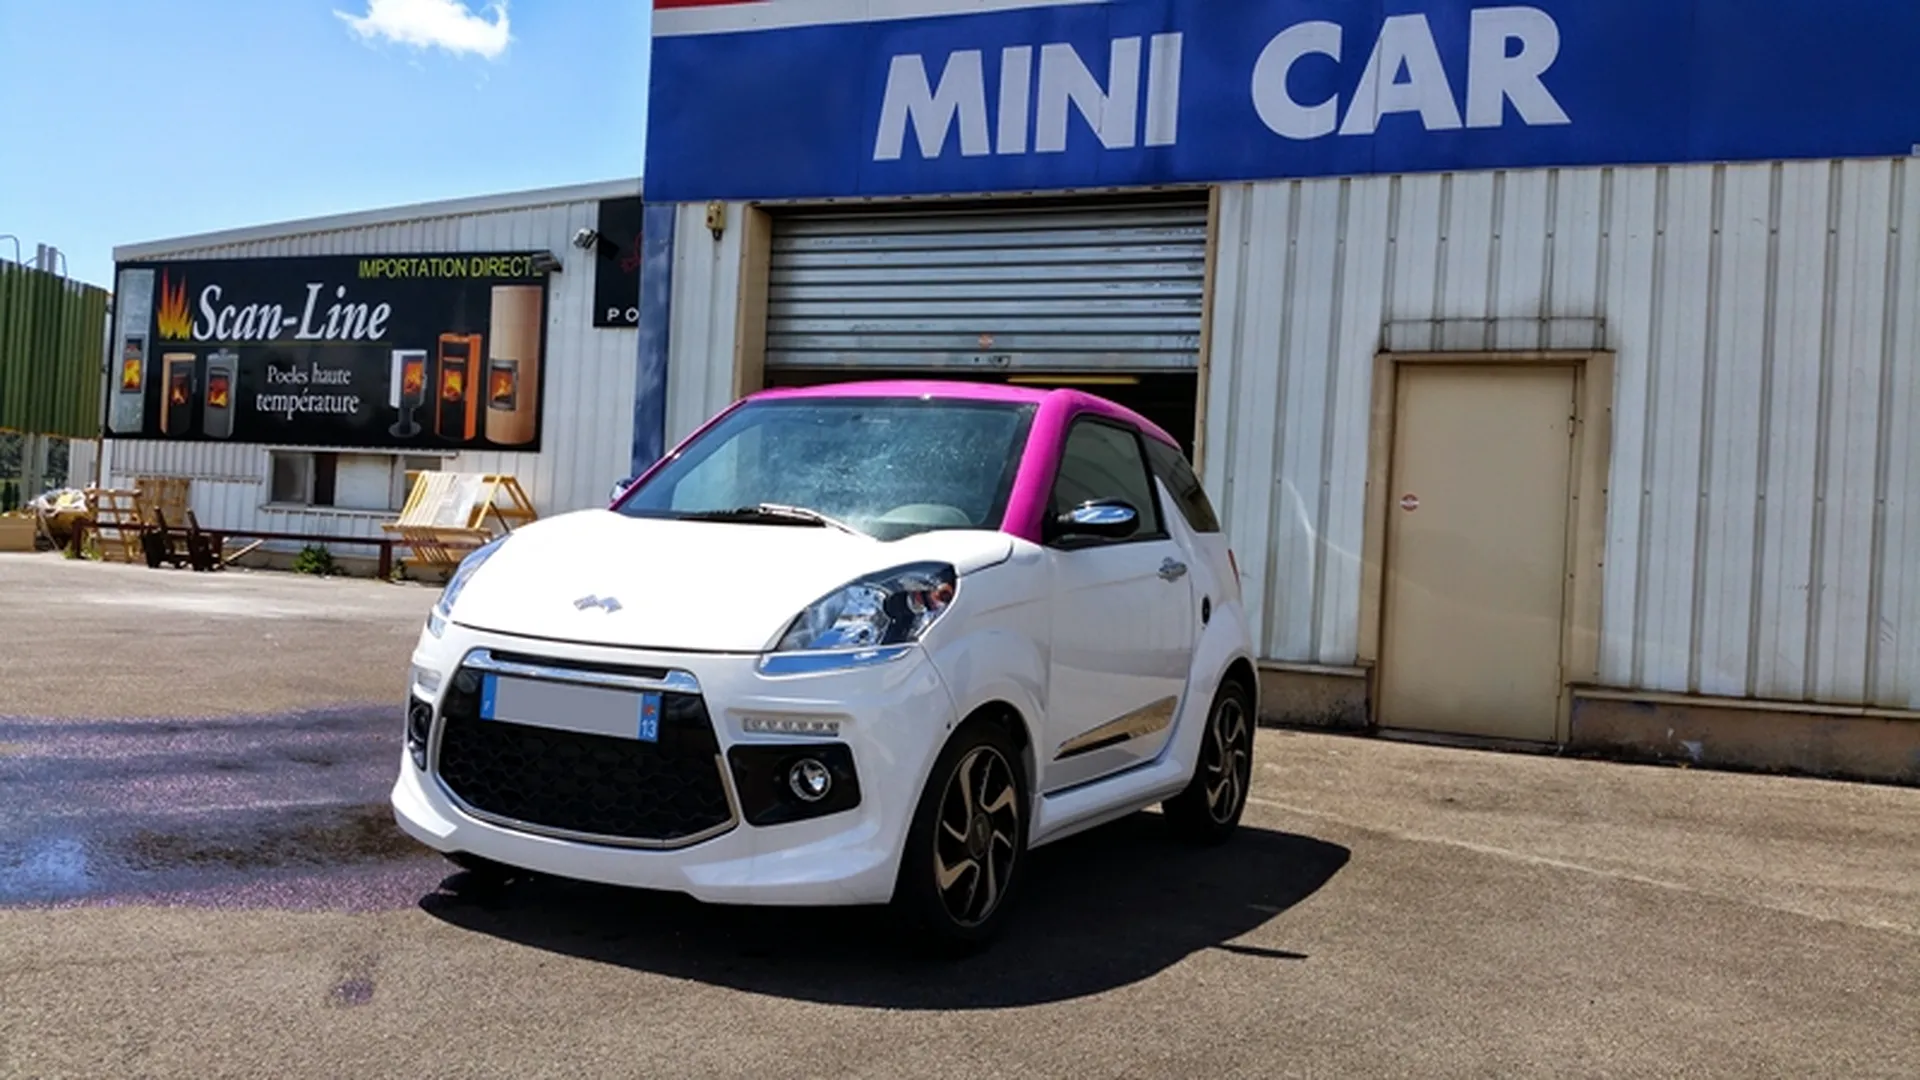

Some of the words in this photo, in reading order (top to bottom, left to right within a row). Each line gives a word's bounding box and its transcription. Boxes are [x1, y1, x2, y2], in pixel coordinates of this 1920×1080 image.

[873, 32, 1184, 161] MINI
[1251, 6, 1572, 140] CAR
[358, 258, 468, 279] IMPORTATION
[192, 282, 392, 341] Scan-Line
[312, 361, 352, 385] haute
[256, 387, 360, 421] température
[641, 719, 658, 738] 13
